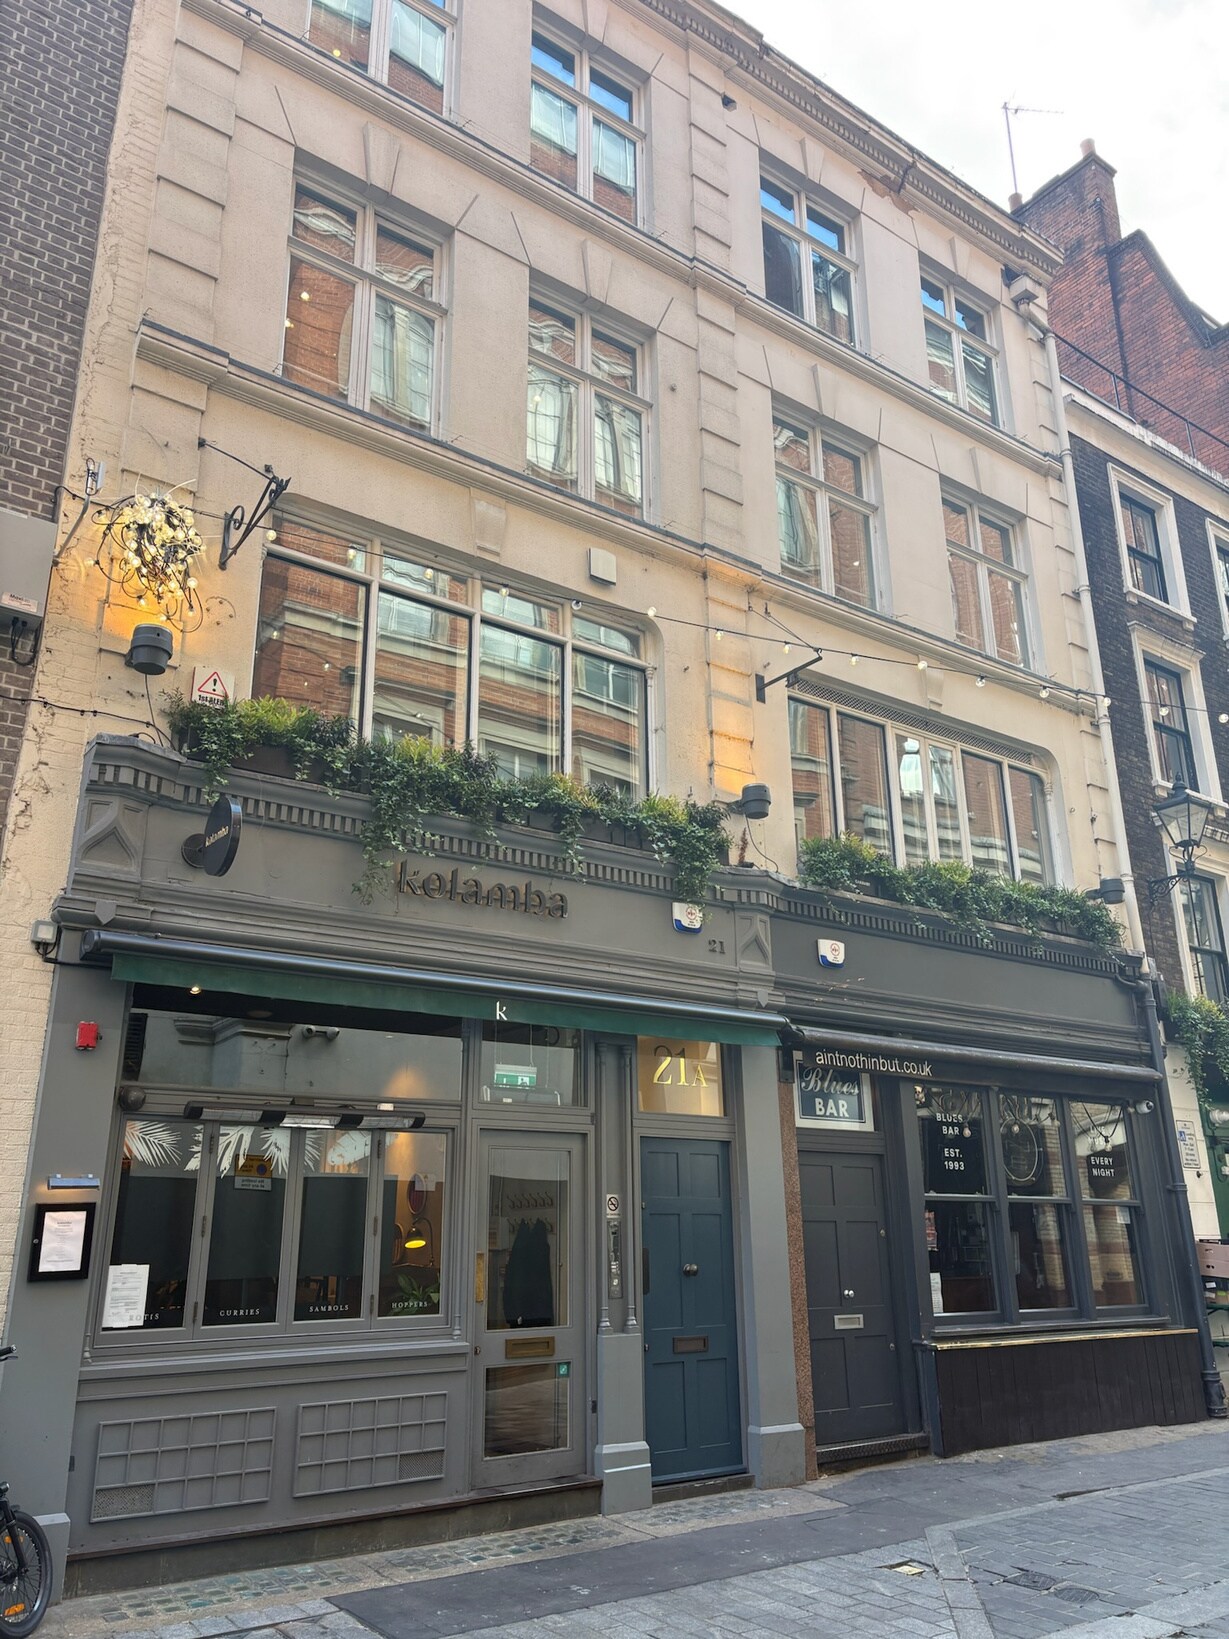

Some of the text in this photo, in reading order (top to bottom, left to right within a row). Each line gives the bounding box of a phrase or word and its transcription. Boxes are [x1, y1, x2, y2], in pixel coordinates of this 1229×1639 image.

[399, 859, 568, 918] kolamba
[708, 939, 726, 955] 21
[495, 1001, 508, 1021] k
[653, 1045, 708, 1087] 21A
[815, 1049, 932, 1077] aintnothinbut.co.uk
[801, 1066, 860, 1096] Blues
[815, 1097, 849, 1118] BAR
[936, 1112, 963, 1123] BLUES
[942, 1126, 960, 1136] BAR
[944, 1148, 963, 1158] EST.
[944, 1161, 965, 1171] 1993
[1091, 1156, 1113, 1166] EVERY
[1092, 1168, 1115, 1177] NIGHT
[309, 1304, 350, 1313] SAMBOLS
[391, 1301, 428, 1309] HOPPERS
[219, 1308, 260, 1317] CURRIES
